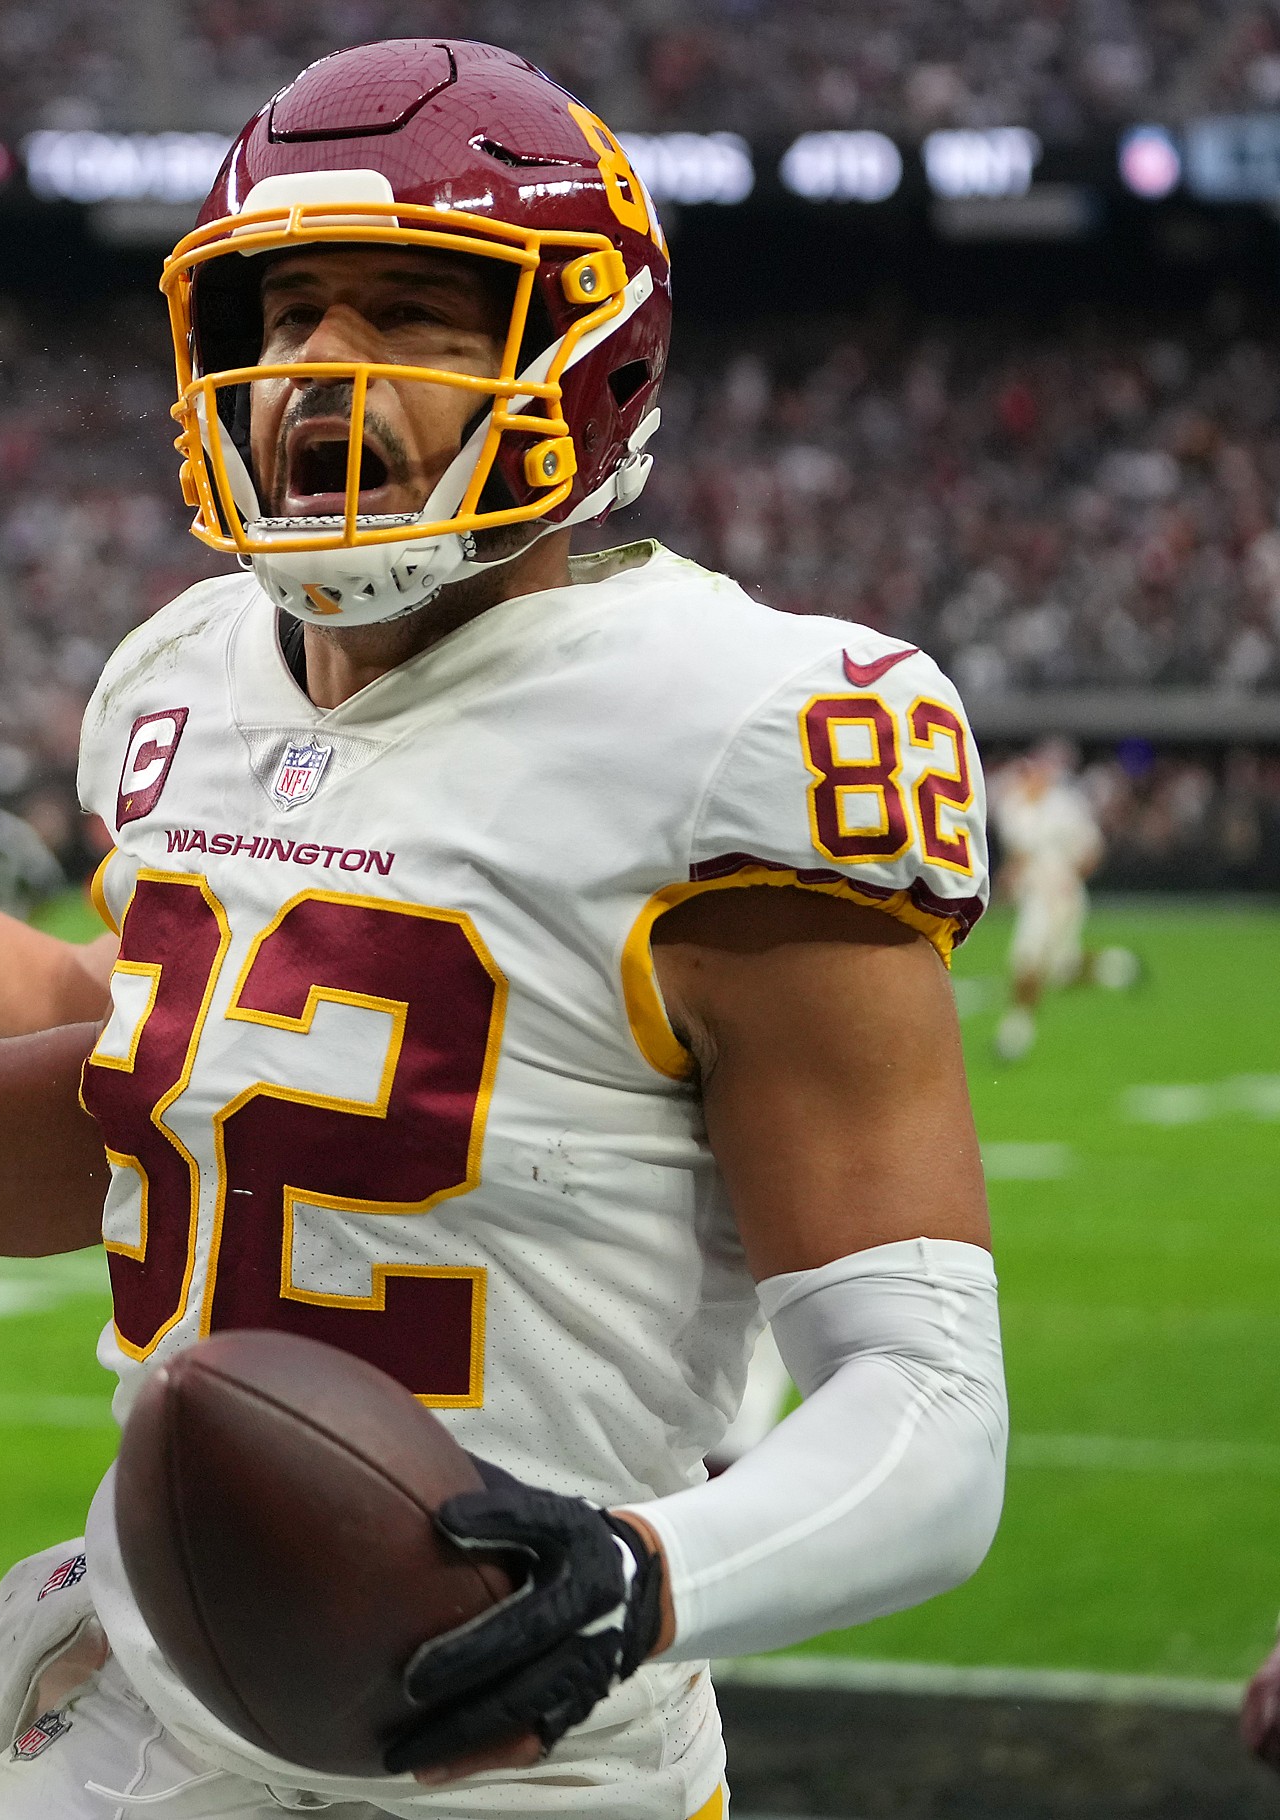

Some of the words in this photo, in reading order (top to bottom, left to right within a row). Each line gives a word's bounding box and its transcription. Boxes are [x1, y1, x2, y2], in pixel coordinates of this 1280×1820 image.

[568, 102, 669, 262] 8
[121, 717, 177, 796] C
[278, 769, 315, 796] NFL
[798, 691, 974, 877] 82
[165, 829, 395, 876] WASHINGTON
[79, 867, 509, 1408] 82
